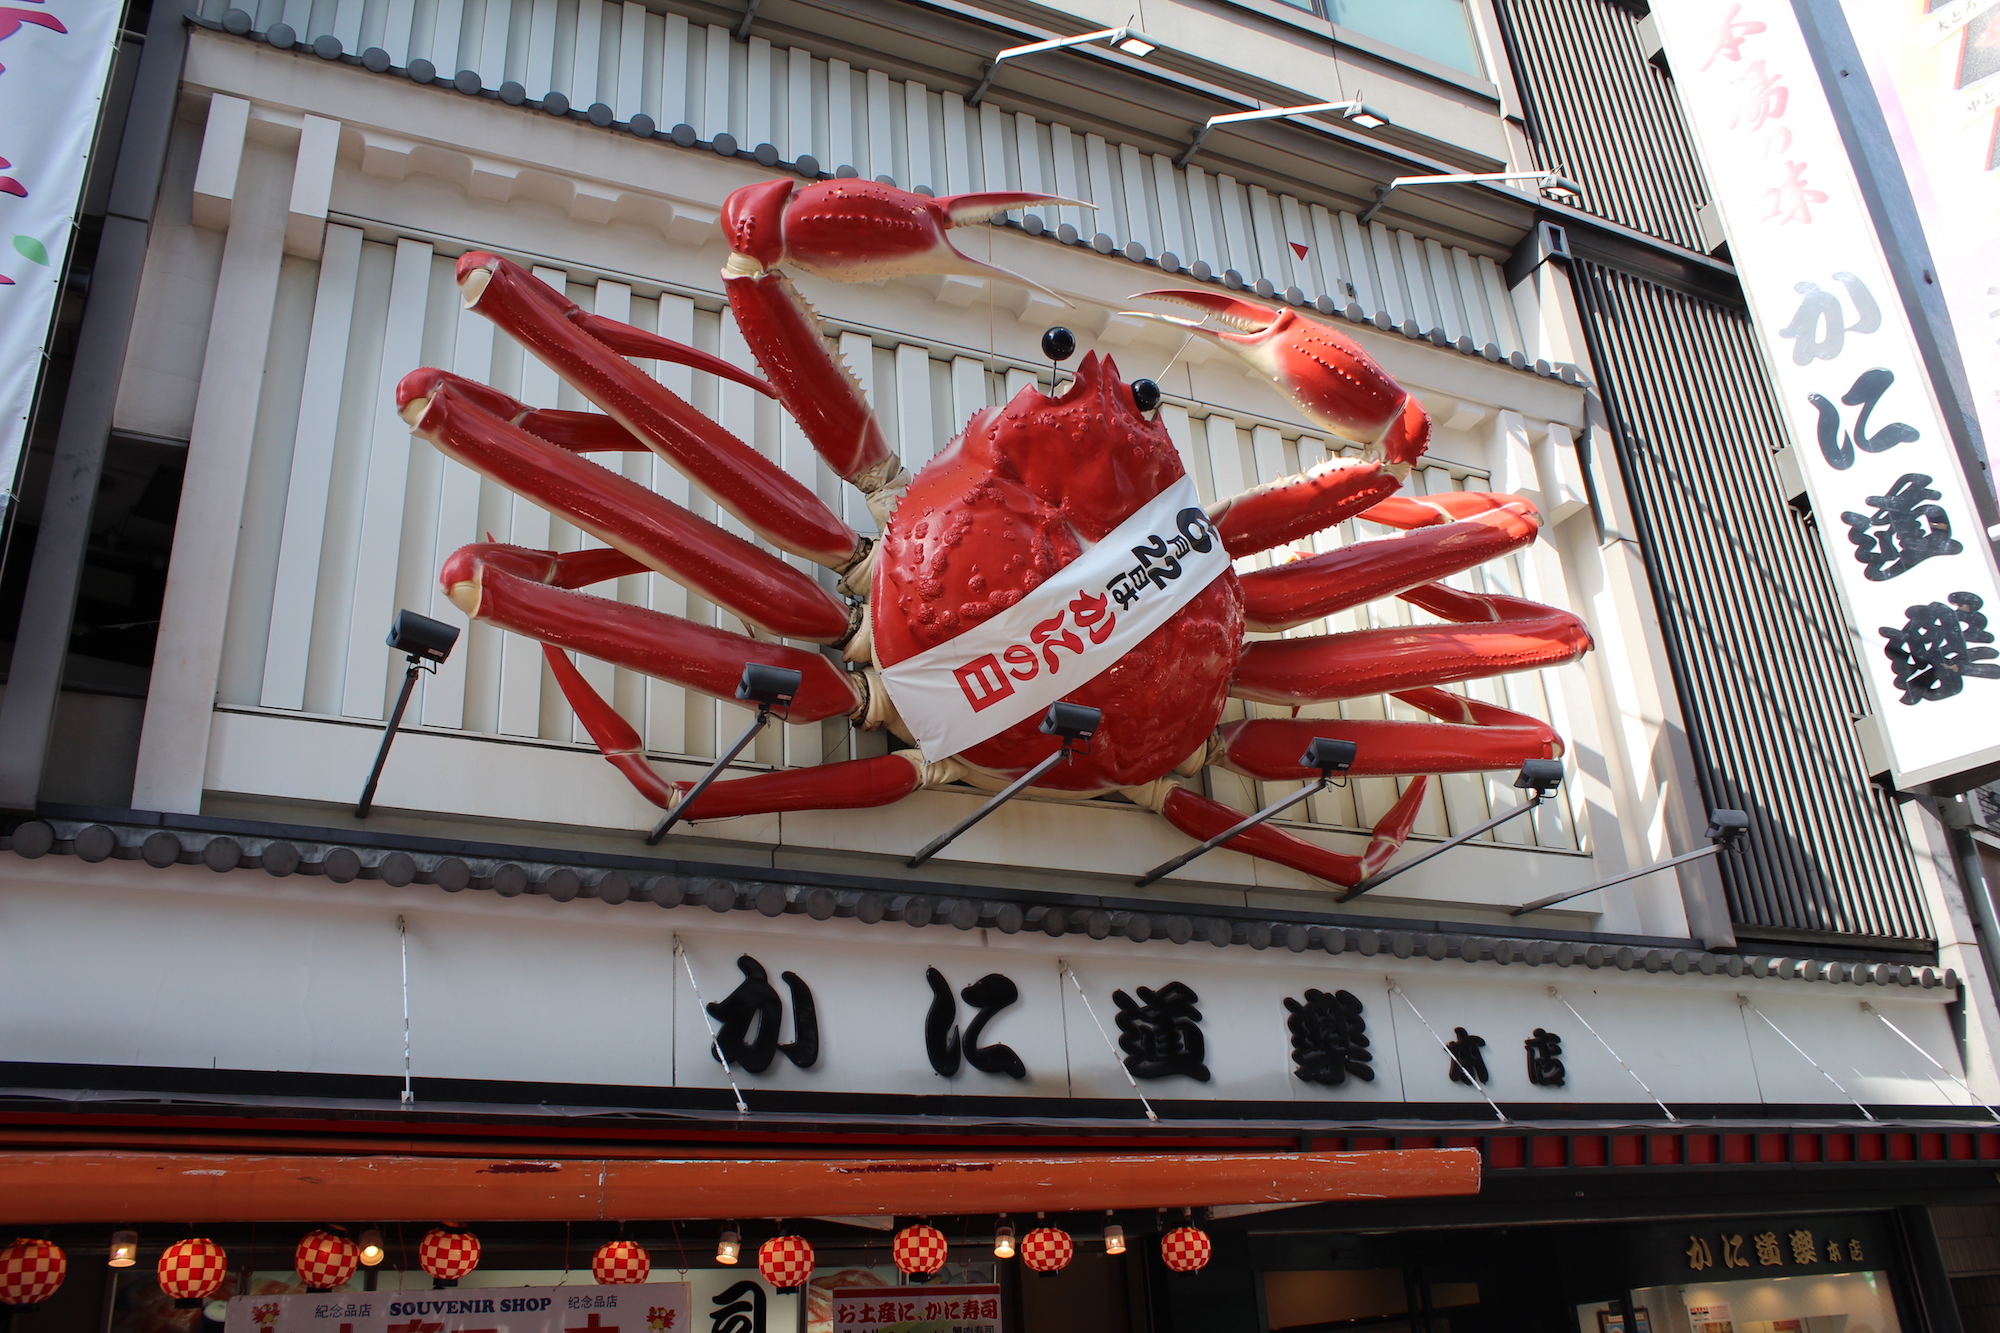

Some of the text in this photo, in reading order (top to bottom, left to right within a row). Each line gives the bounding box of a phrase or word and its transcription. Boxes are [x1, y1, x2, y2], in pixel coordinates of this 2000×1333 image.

[1967, 91, 2000, 113] 中と
[314, 1303, 372, 1318] 紀念品店
[389, 1297, 552, 1317] SOUVENIR SHOP
[567, 1295, 618, 1309] 纪念品店
[837, 1299, 998, 1324] お土産に、かに寿司
